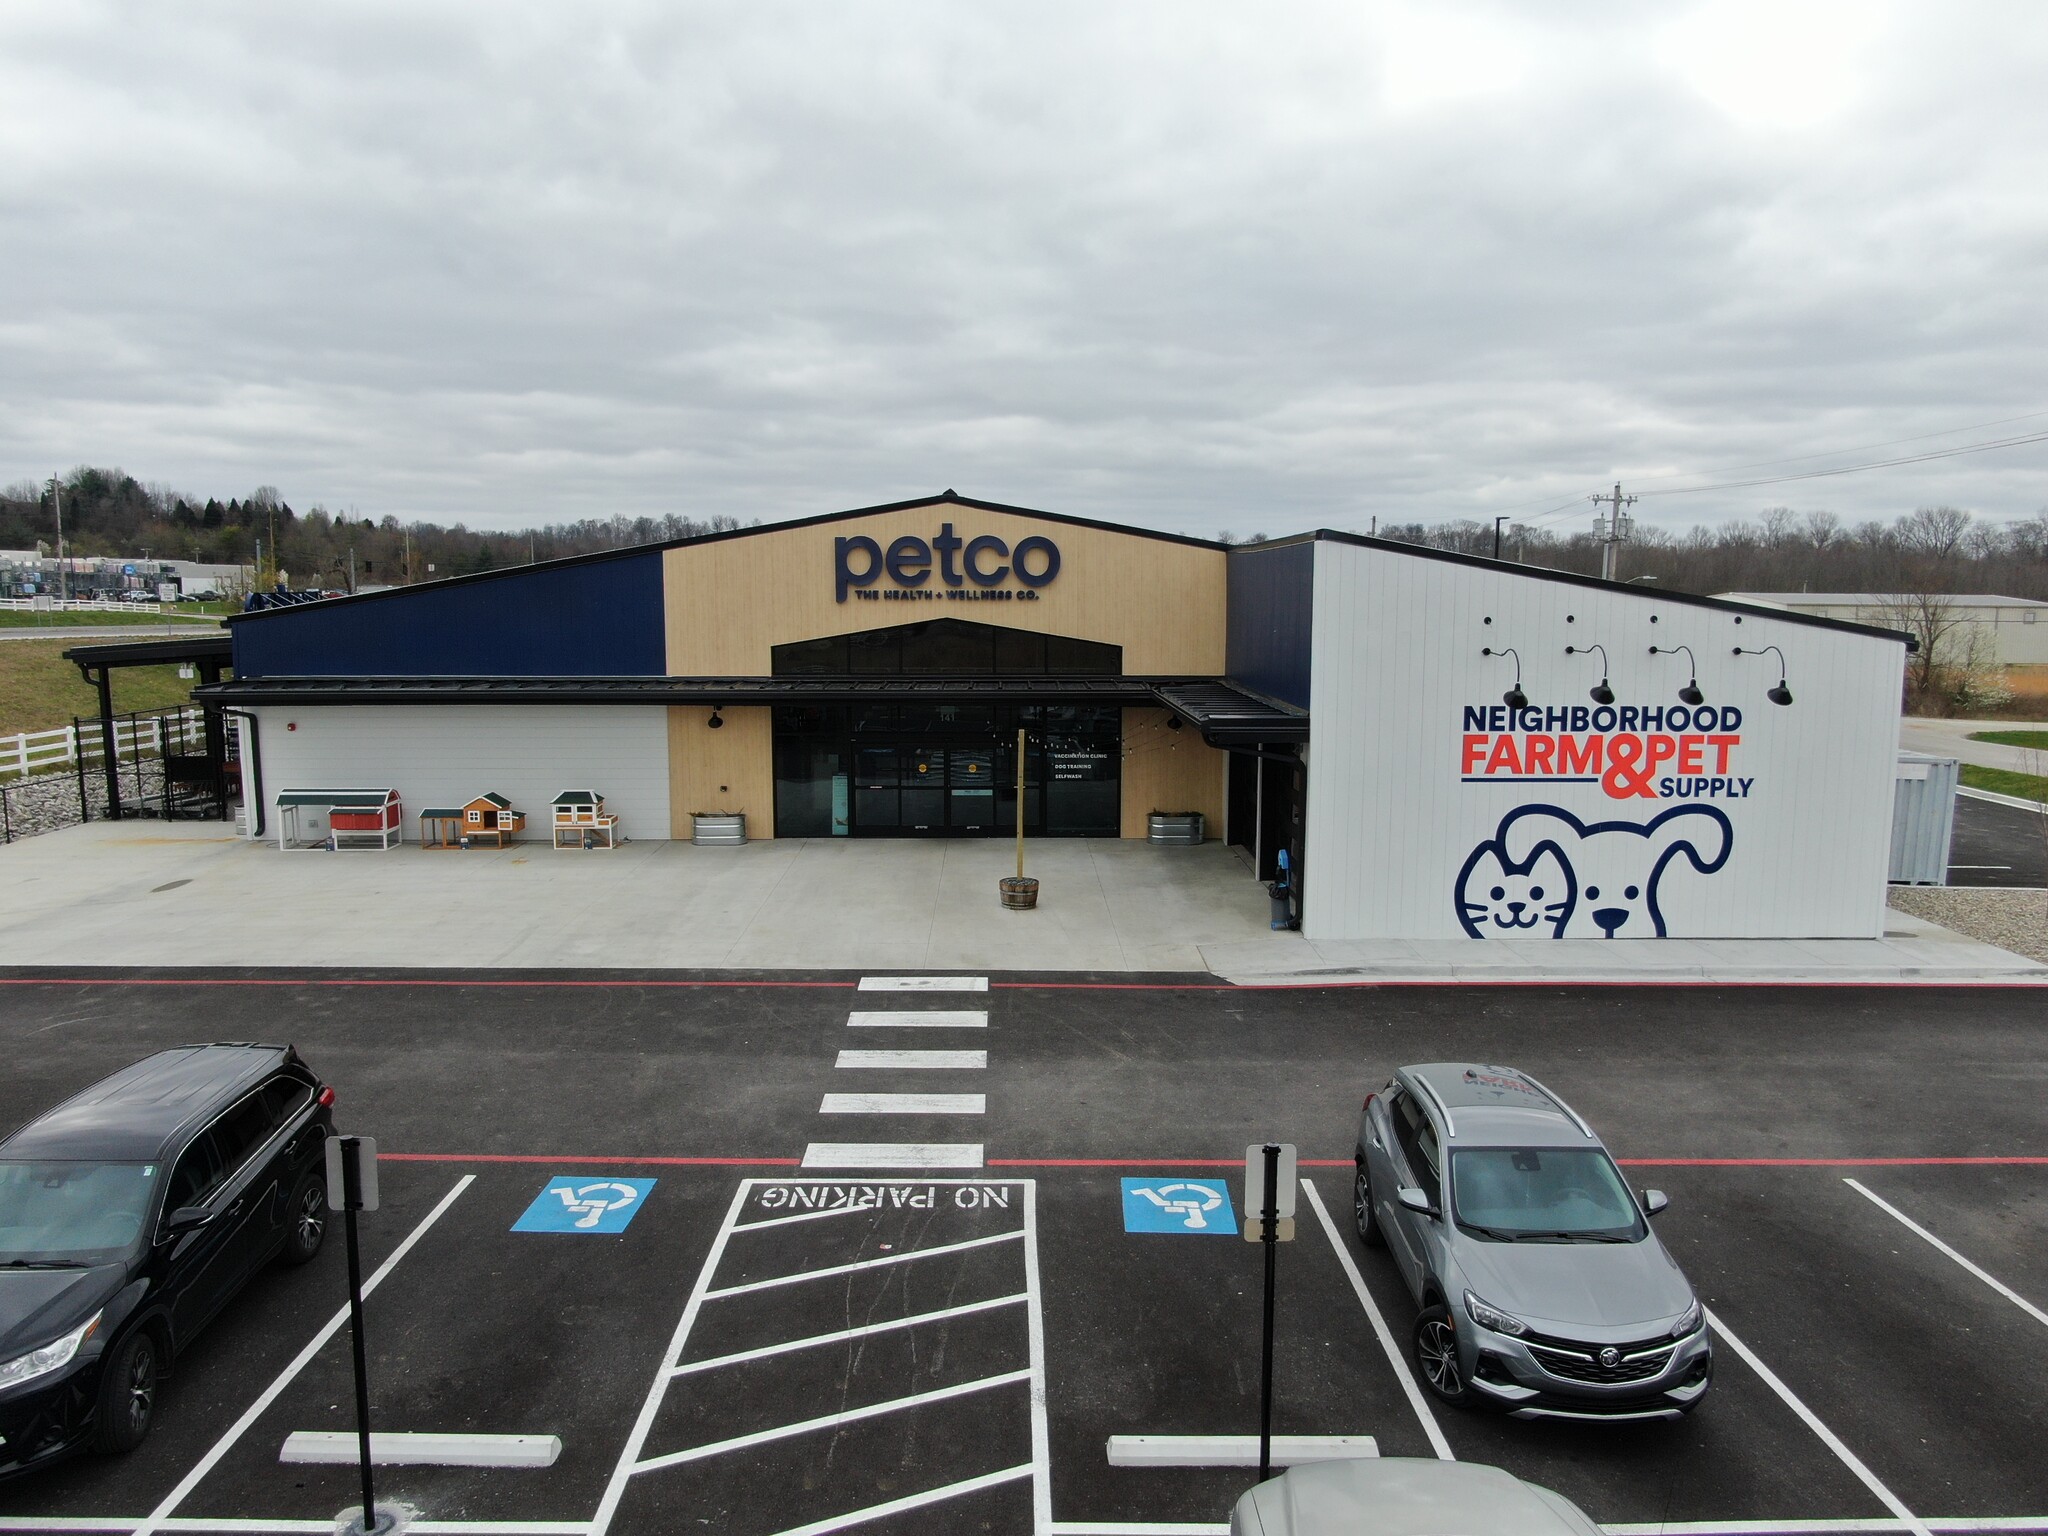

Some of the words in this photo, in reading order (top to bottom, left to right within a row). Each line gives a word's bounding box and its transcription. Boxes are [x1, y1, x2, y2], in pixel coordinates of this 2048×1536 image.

[834, 522, 1061, 604] petco
[855, 590, 879, 600] THE
[884, 590, 933, 600] HEALTH
[946, 590, 1012, 600] WELLNESS
[1016, 590, 1040, 600] CO.
[1463, 705, 1742, 732] NEIGHBORHOOD
[1659, 778, 1754, 798] SUPPLY
[761, 1186, 935, 1208] PARKING
[954, 1186, 1008, 1208] NO
